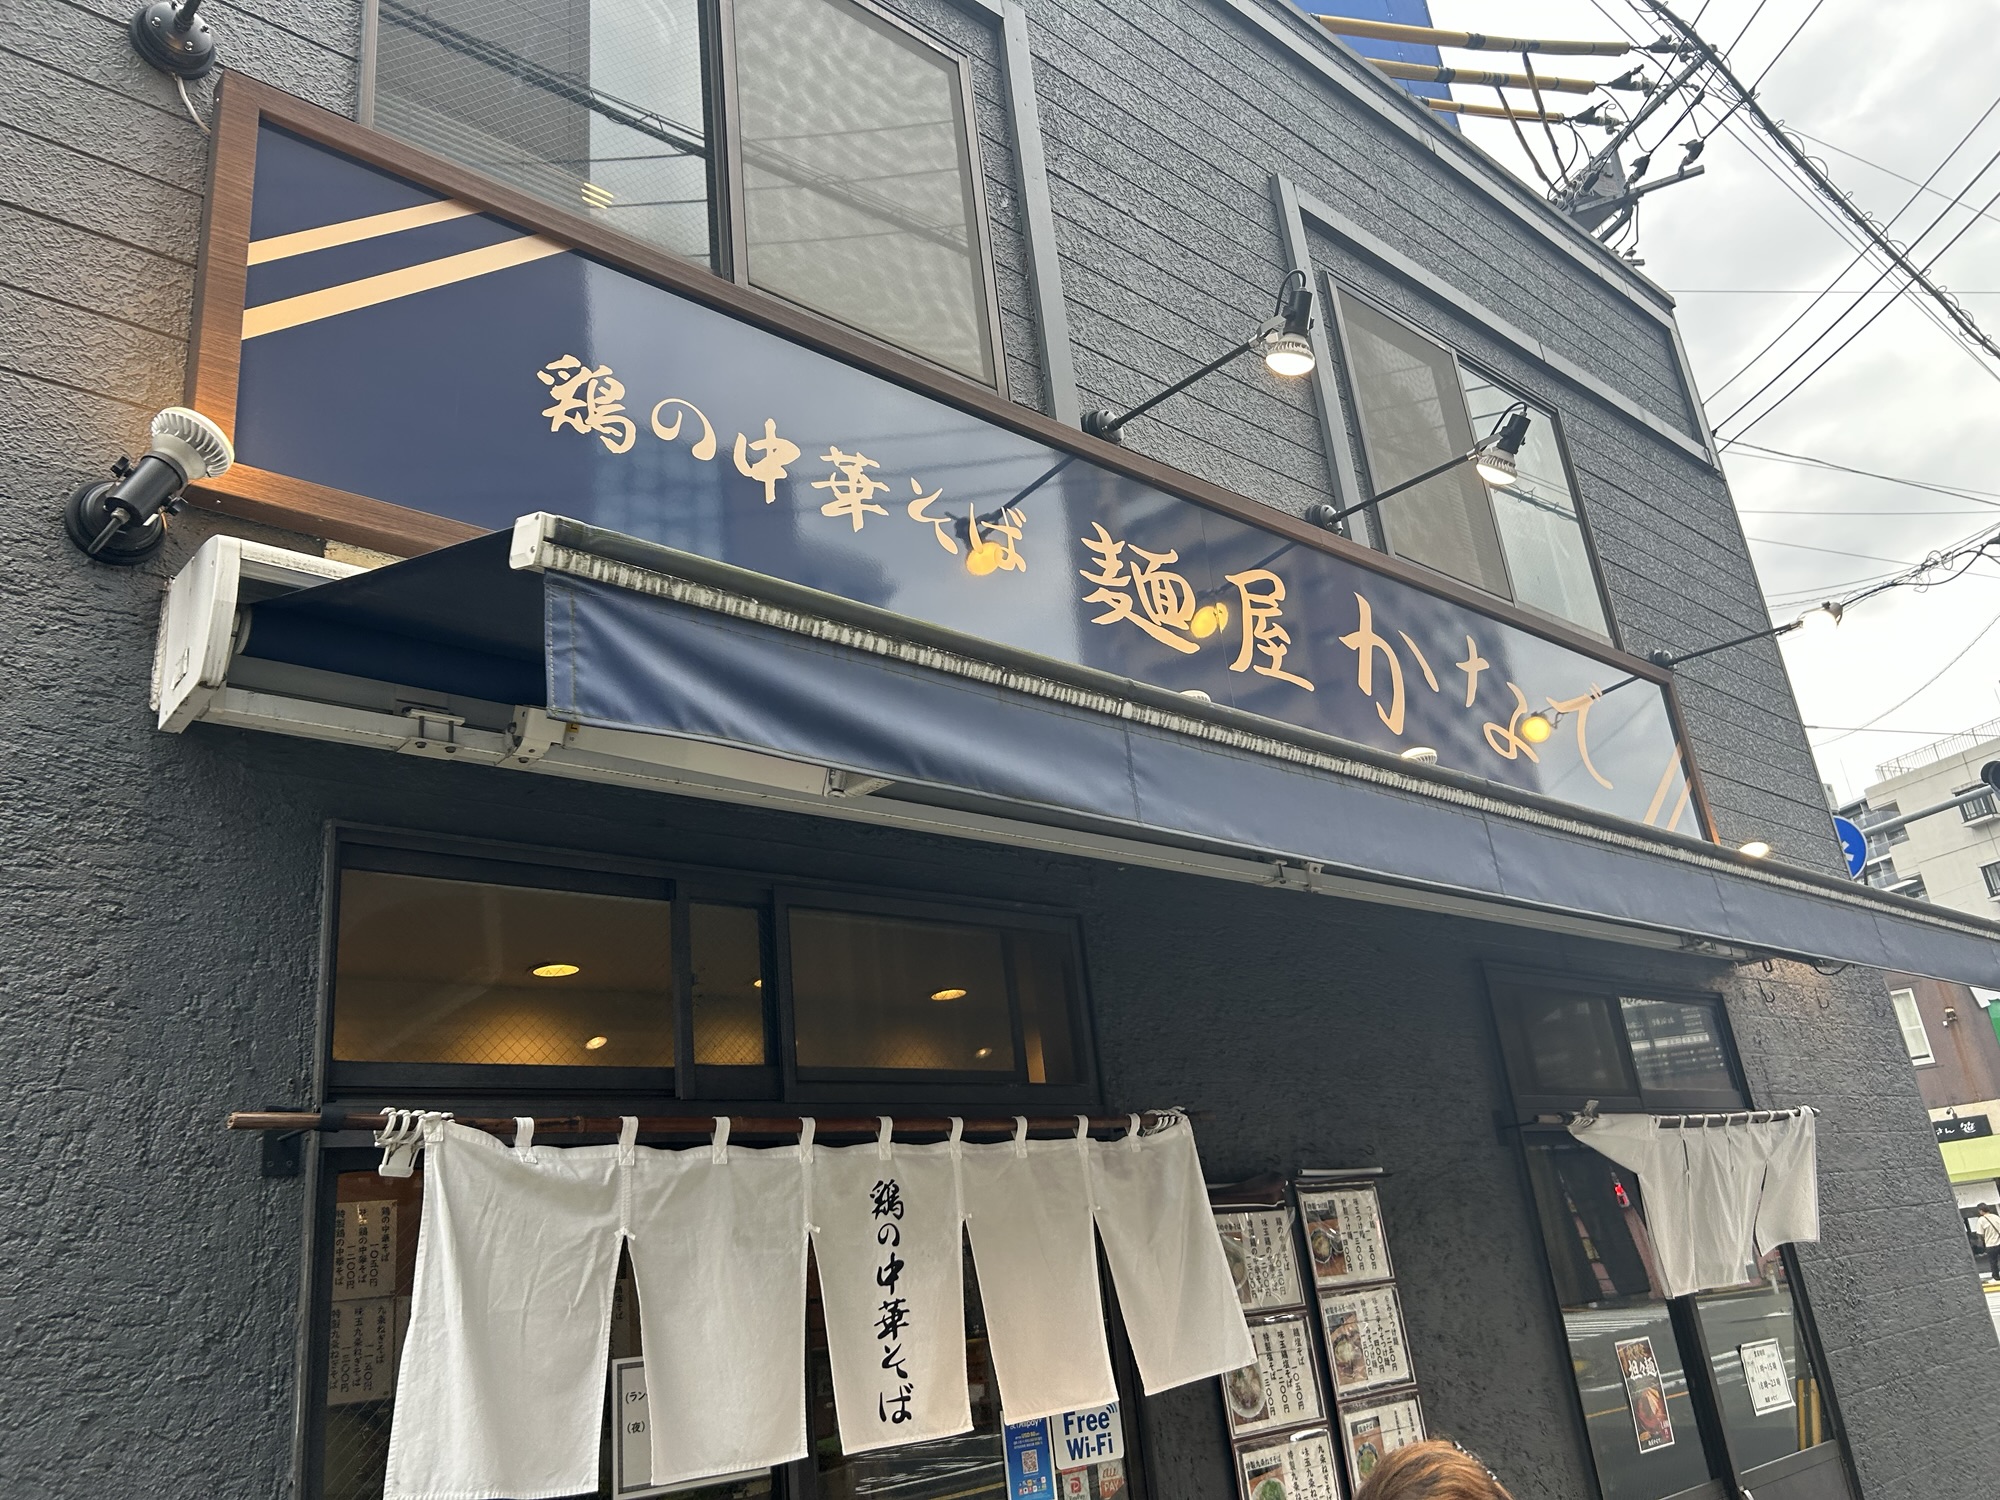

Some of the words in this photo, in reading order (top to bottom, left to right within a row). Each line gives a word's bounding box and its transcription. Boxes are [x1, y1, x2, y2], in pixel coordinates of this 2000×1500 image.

[537, 354, 1028, 573] 鶏の中華そば
[381, 1206, 390, 1262] 鶏の中華そば
[869, 1179, 914, 1424] 鶏の中華そば
[376, 1305, 386, 1364] 九条ねぎそば
[1063, 1411, 1110, 1435] Free
[1066, 1432, 1114, 1460] Wi-Fi
[1104, 1480, 1120, 1492] PAY
